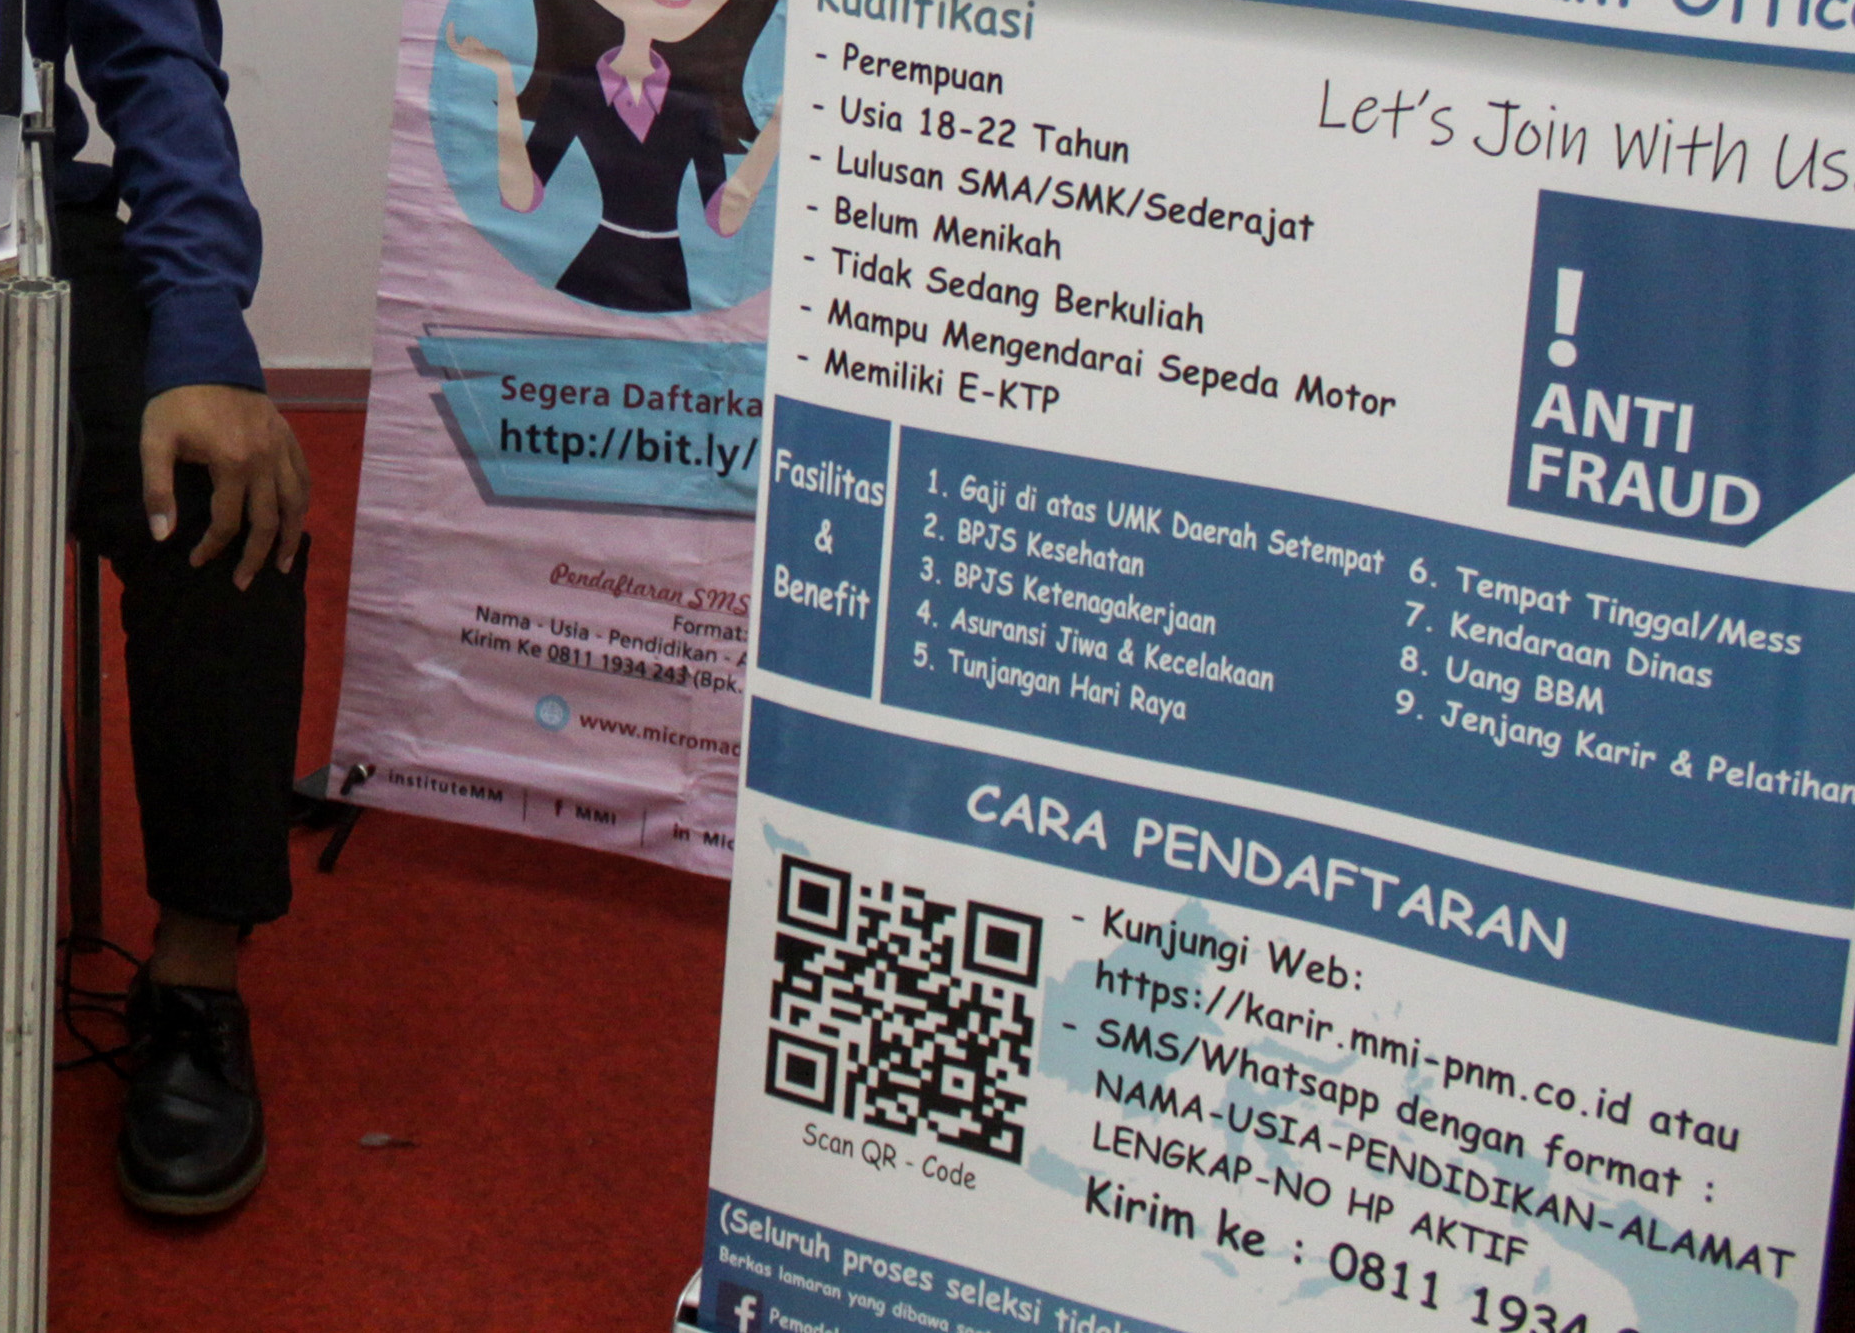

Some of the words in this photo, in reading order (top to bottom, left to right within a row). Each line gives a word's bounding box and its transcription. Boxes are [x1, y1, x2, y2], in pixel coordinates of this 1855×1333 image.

[843, 43, 1002, 95] Perempuan
[841, 96, 901, 132] Usia
[921, 108, 1015, 147] 18-22
[1033, 123, 1128, 163] Tahun
[1473, 100, 1586, 165] Join
[1615, 119, 1747, 183] With
[836, 196, 917, 238] Belum
[933, 215, 1060, 260] Menikah
[837, 146, 942, 190] Lulusan
[958, 168, 1314, 246] SMA/SMK/Sederajat
[832, 247, 911, 288] Tidak
[927, 267, 1038, 317] Sedang
[1056, 284, 1202, 334] Berkuliah
[825, 348, 943, 395] Memiliki
[959, 372, 1059, 413] E-KTP
[828, 298, 927, 347] Mampu
[943, 320, 1141, 376] Mengendarai
[1159, 355, 1277, 398] Sepeda
[1295, 374, 1396, 416] Motor
[502, 375, 609, 410] Segera
[624, 384, 762, 417] Daftarka
[1532, 383, 1693, 453] ANTI
[500, 418, 757, 477] http://bit.ly/
[775, 448, 884, 506] Fasilitas
[1528, 444, 1760, 524] FRAUD
[958, 518, 1016, 552] BPJS
[1027, 531, 1144, 577] Kesehatan
[960, 474, 1006, 513] Gaji
[1047, 495, 1096, 522] atas
[1107, 501, 1161, 534] UMK
[1172, 511, 1256, 550] Daerah
[1268, 529, 1384, 576] Setempat
[550, 562, 682, 605] Pendaftaran
[774, 564, 870, 619] Benefit
[955, 561, 1013, 596] BPJS
[1023, 575, 1215, 635] Ketenagakerjaan
[1456, 566, 1571, 614] Tempat
[1586, 593, 1801, 658] Tinggal/Mess
[460, 628, 511, 652] Kirim
[547, 644, 592, 666] 0811
[476, 605, 531, 630] Nama
[551, 618, 589, 640] Usia
[609, 628, 717, 662] Pendidikan
[951, 608, 1046, 646] Asuransi
[1056, 626, 1107, 660] Jiwa
[1145, 643, 1273, 691] Kecelakaan
[1451, 611, 1610, 669] Kendaraan
[1626, 647, 1712, 687] Dinas
[948, 648, 1060, 696] Tunjangan
[1071, 673, 1120, 706] Hari
[1130, 685, 1185, 724] Raya
[1446, 656, 1520, 703] Uang
[1535, 675, 1603, 714] BBM
[1441, 700, 1561, 757] Jenjang
[1575, 730, 1656, 769] Karir
[1707, 755, 1855, 804] Pelatihan
[967, 784, 1106, 850] CARA
[1134, 818, 1566, 959] PENDAFTARAN
[1104, 906, 1248, 972] Kunjungi
[1269, 941, 1361, 990] Web:
[1096, 1018, 1378, 1116] SMS/Whatsapp
[1397, 1094, 1527, 1158] dengan
[1545, 1134, 1681, 1197] format
[1650, 1099, 1739, 1152] atau
[803, 1123, 853, 1157] Scan
[922, 1155, 975, 1189] Code
[1093, 1122, 1332, 1208] LENGKAP-NO
[1410, 1212, 1528, 1266] AKTIF
[721, 1202, 829, 1262] (Seluruh
[843, 1249, 933, 1291] proses
[946, 1279, 1041, 1324] seleksi
[1086, 1176, 1195, 1239] Kirim
[1330, 1243, 1437, 1309] 0811
[719, 1245, 771, 1277] Berkas
[779, 1265, 841, 1299] lamaran
[848, 1292, 885, 1317] yang
[892, 1302, 949, 1332] dibawa
